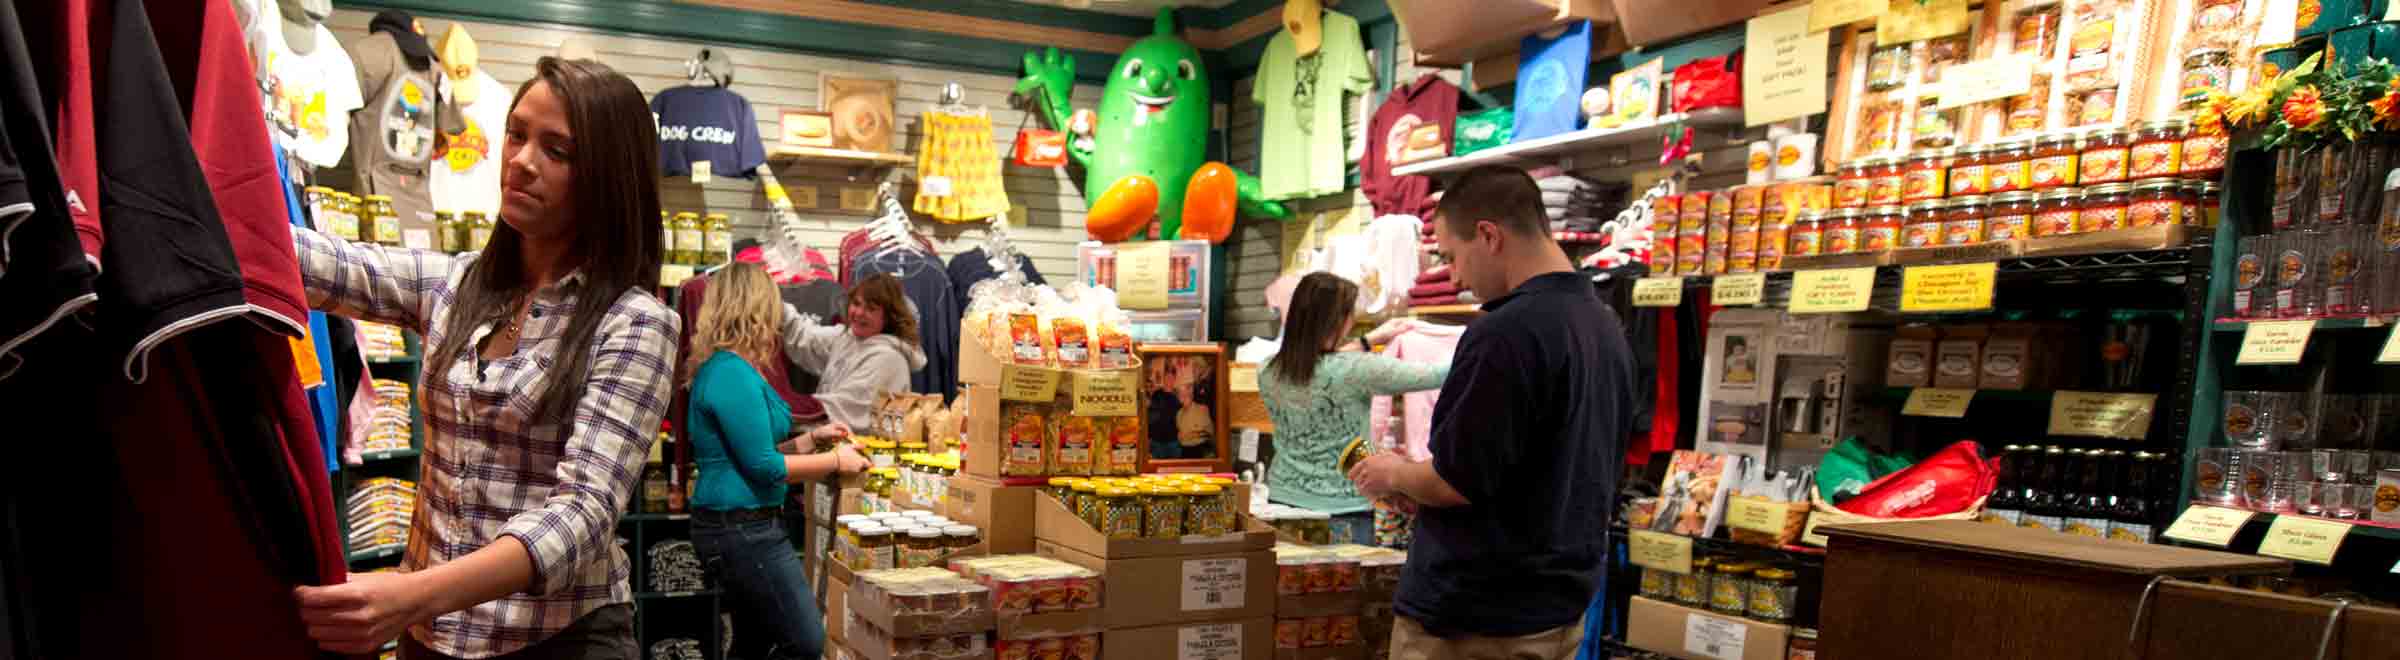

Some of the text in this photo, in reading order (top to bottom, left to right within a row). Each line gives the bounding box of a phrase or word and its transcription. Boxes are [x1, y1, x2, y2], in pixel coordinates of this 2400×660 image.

[660, 126, 736, 144] DOG CREW
[1080, 393, 1133, 405] NOODLES
